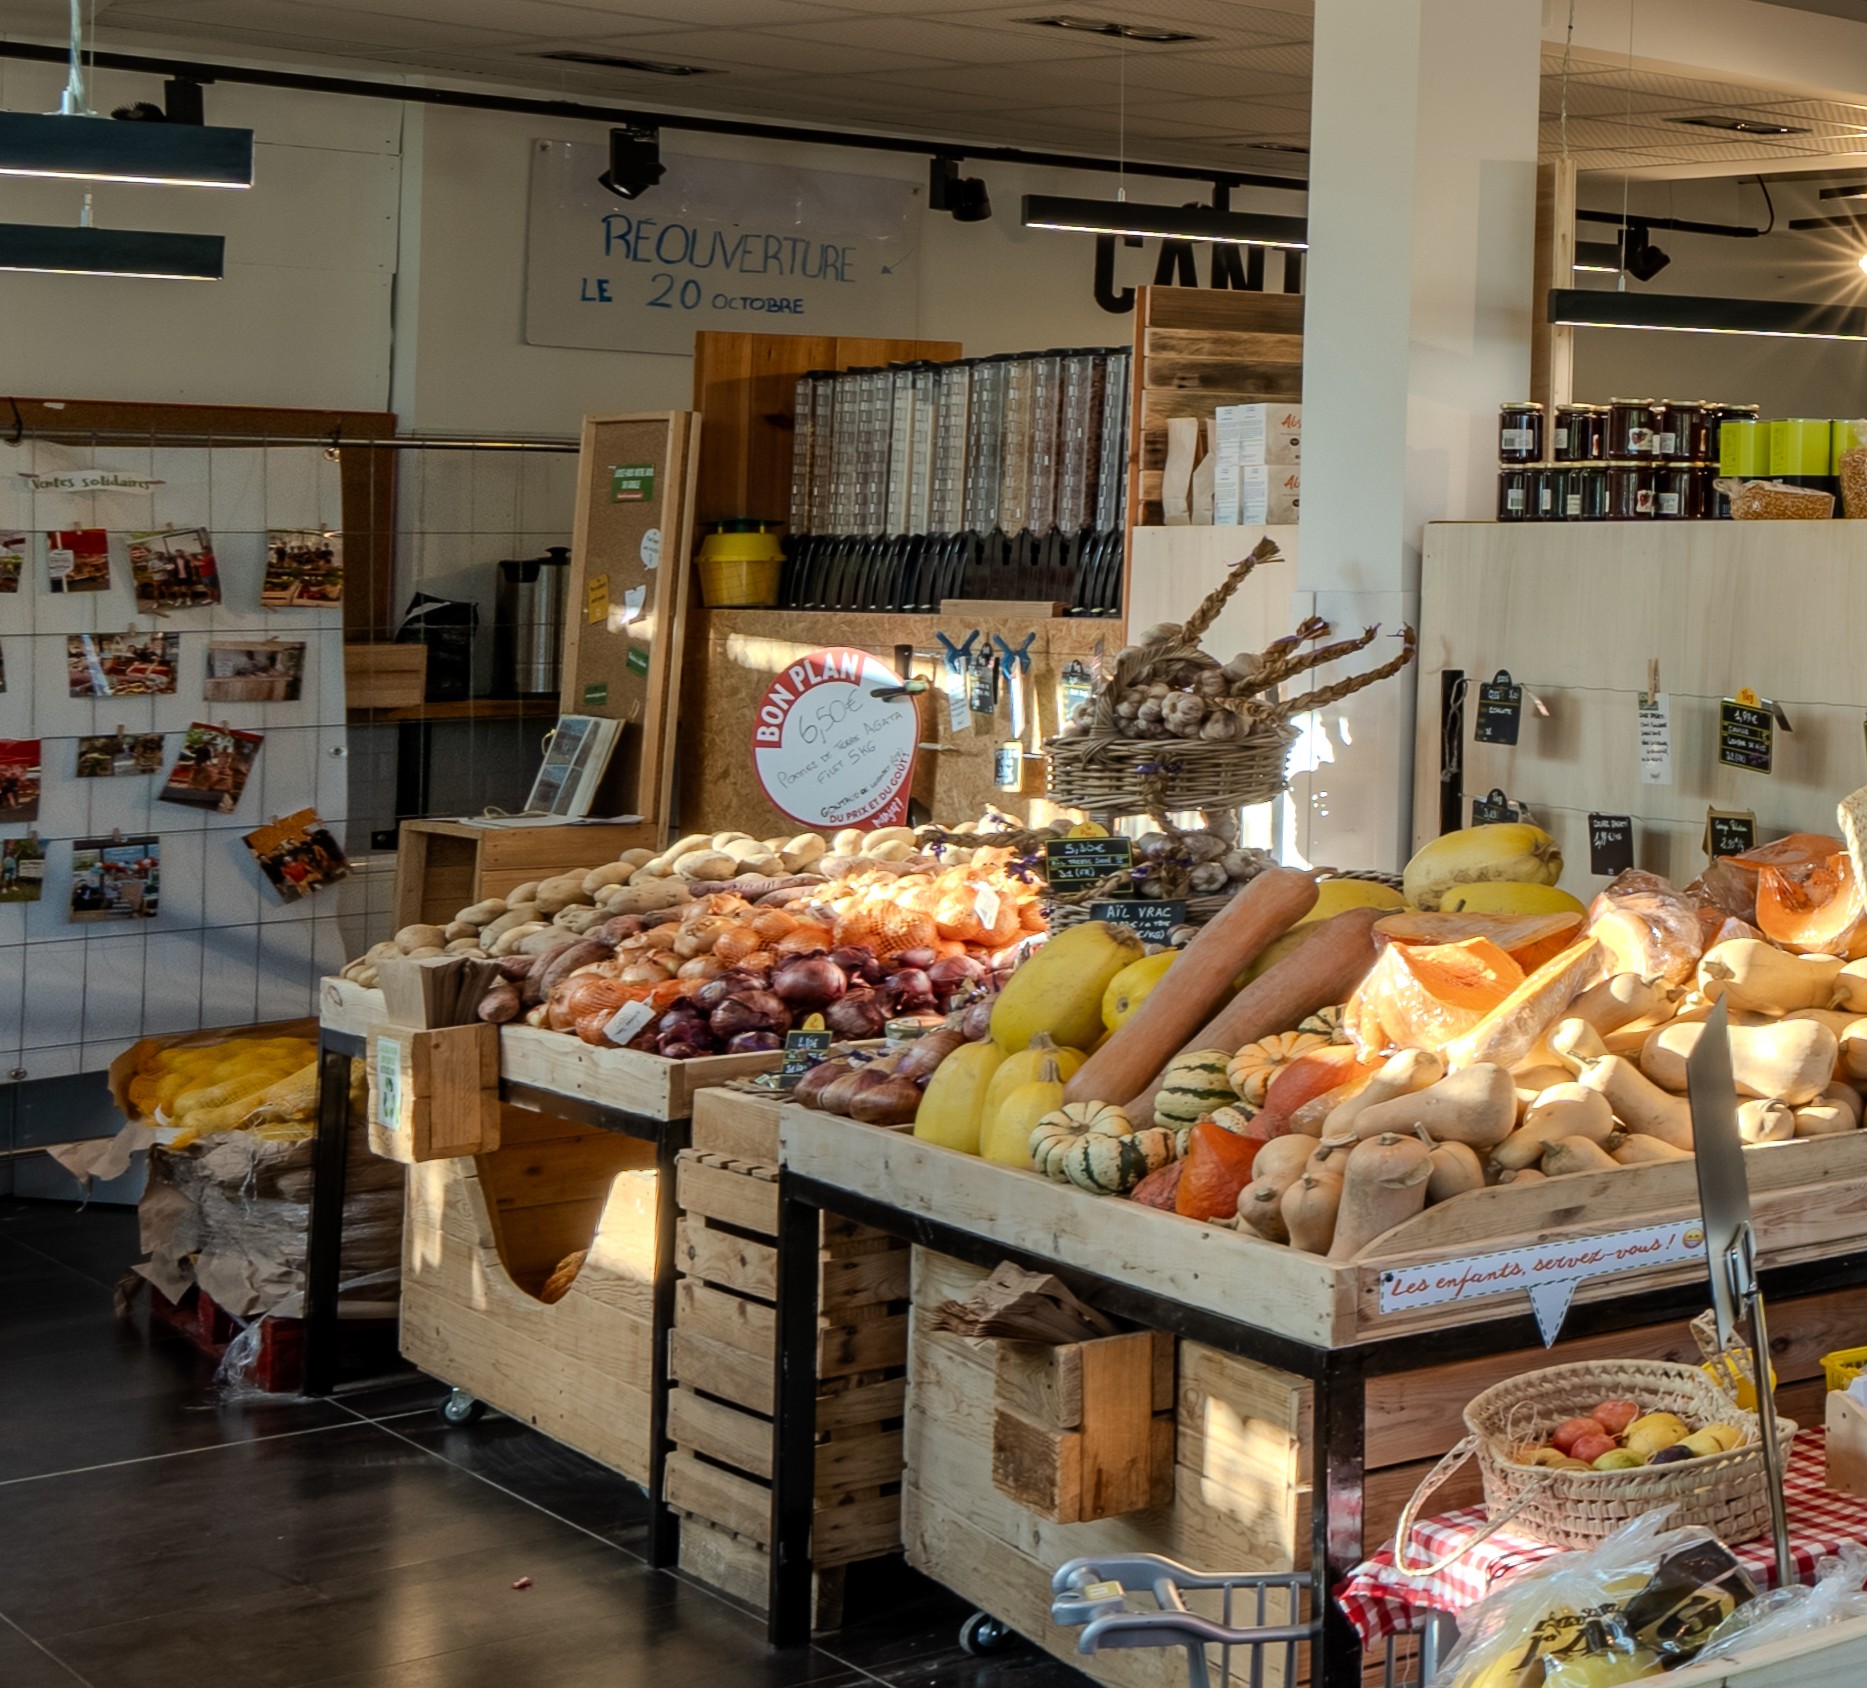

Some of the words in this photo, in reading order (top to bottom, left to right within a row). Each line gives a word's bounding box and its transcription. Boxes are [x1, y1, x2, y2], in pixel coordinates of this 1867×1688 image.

[581, 278, 612, 302] LE
[646, 273, 701, 309] 20
[711, 293, 804, 314] OCTOBRE
[756, 683, 795, 742] BON
[789, 652, 859, 692] PLAN
[798, 689, 863, 744] 6,50€
[829, 813, 844, 823] DU
[847, 804, 869, 820] PRIX
[869, 796, 881, 810] ET
[879, 785, 893, 801] DU
[1138, 906, 1171, 918] VRAC
[1391, 1279, 1429, 1296] Les
[1436, 1265, 1526, 1297] enfants,
[1531, 1239, 1662, 1272] servez-vous
